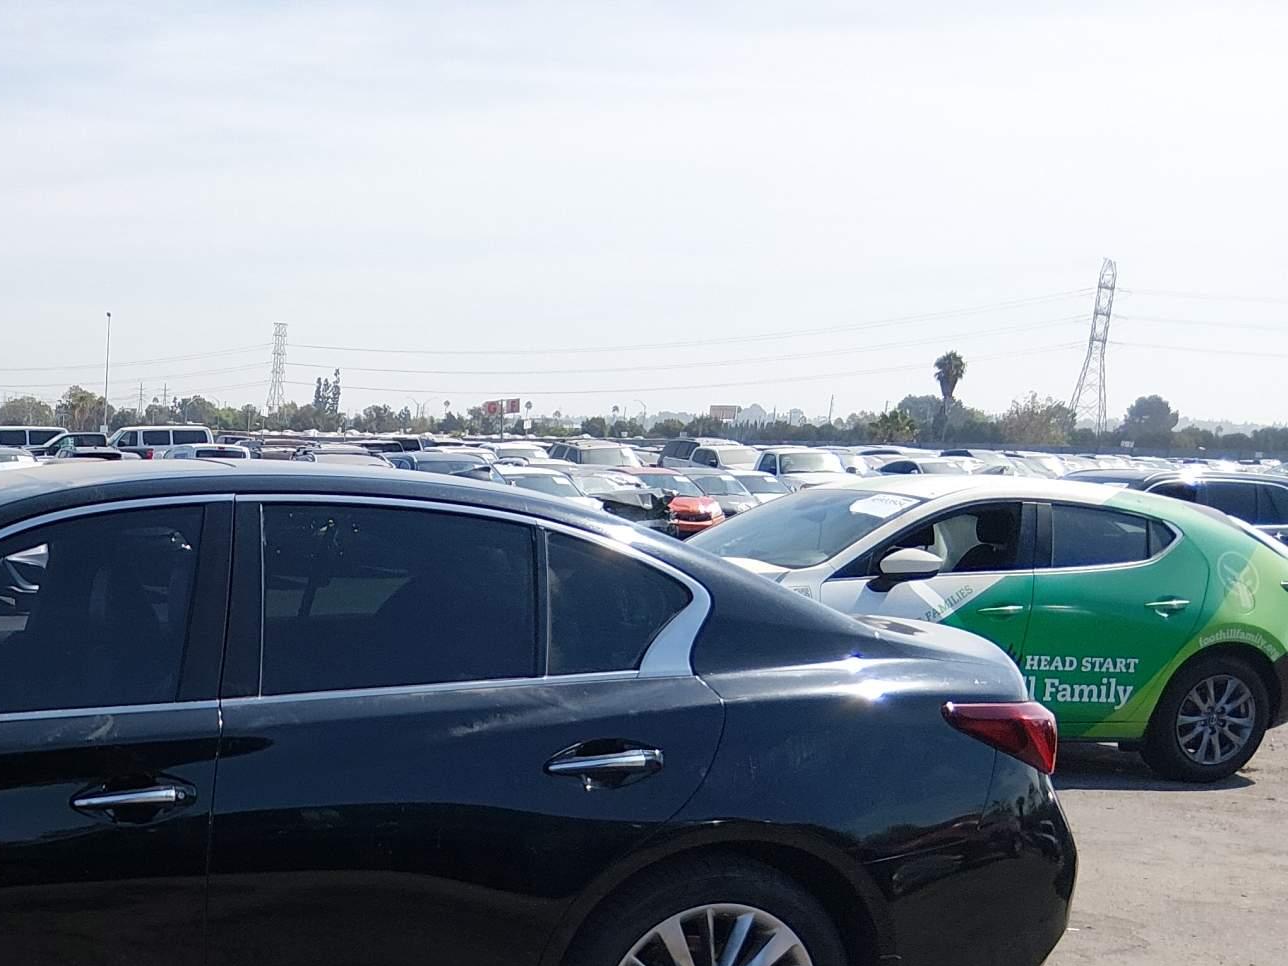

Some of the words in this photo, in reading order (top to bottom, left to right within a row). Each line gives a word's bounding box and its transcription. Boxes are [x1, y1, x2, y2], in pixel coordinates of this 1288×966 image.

[924, 585, 974, 622] FAMILIES
[1025, 655, 1078, 671] HEAD
[1081, 657, 1139, 673] START
[1042, 677, 1134, 710] Family
